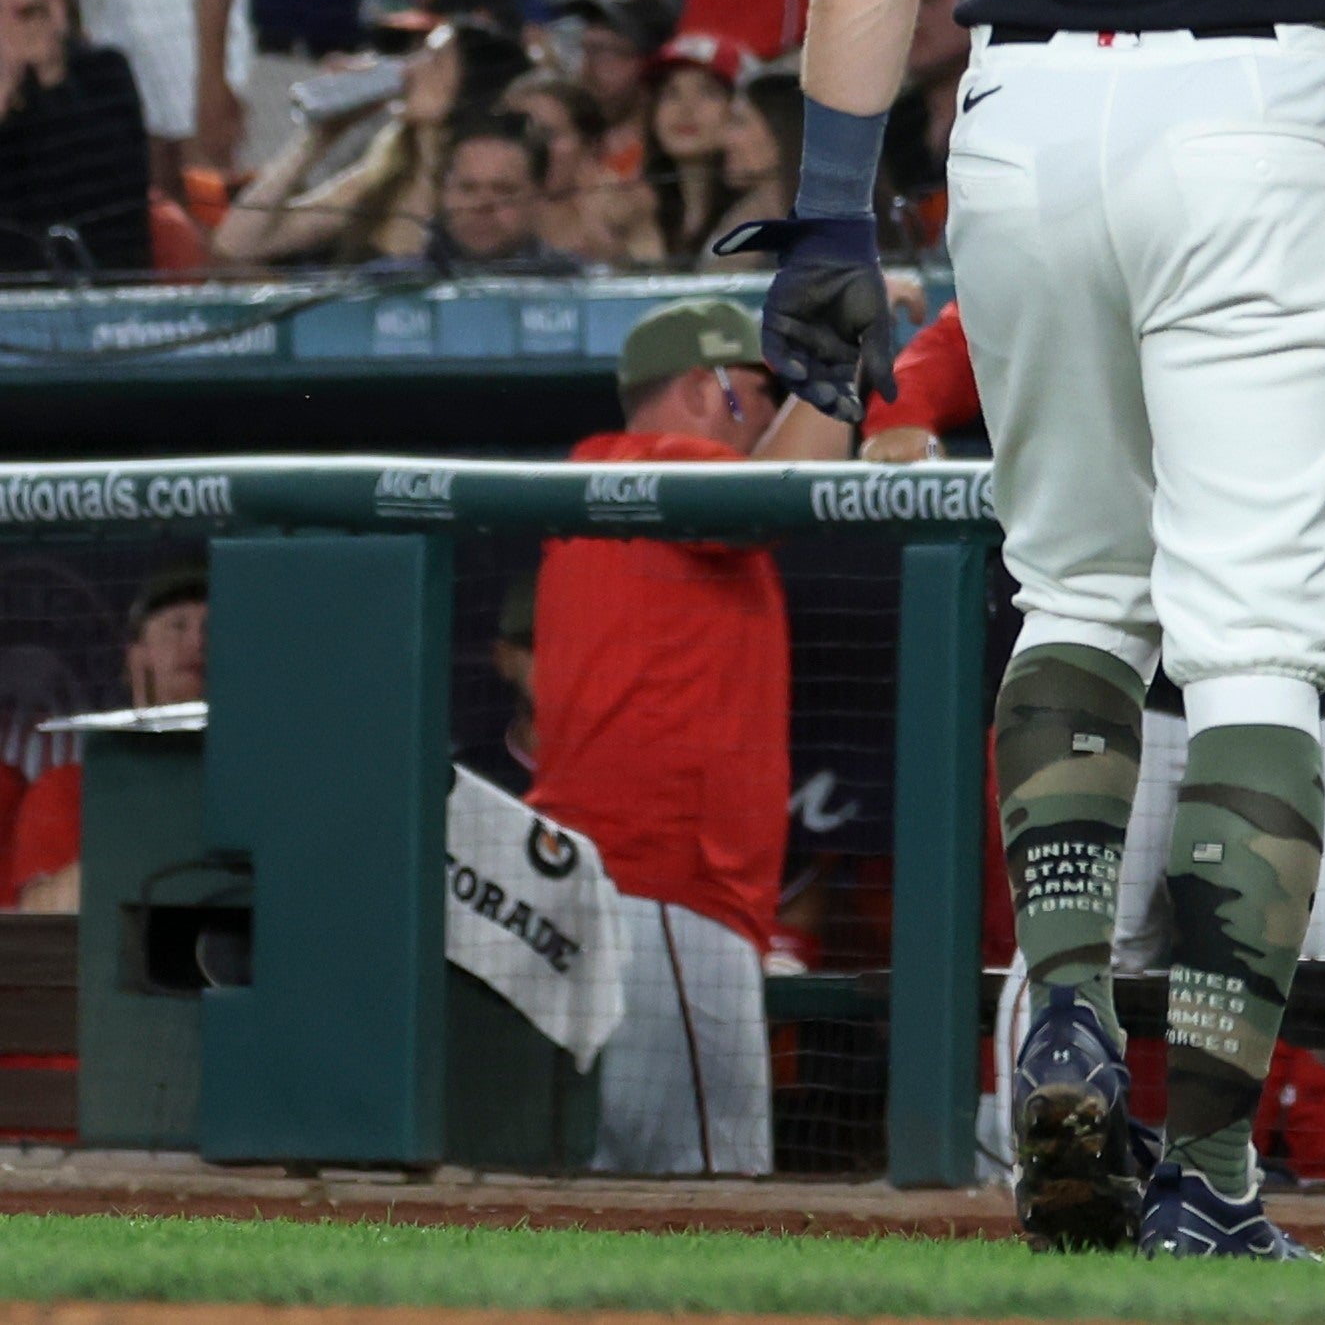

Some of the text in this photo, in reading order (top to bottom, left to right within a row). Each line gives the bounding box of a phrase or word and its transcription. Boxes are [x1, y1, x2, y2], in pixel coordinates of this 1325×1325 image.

[1027, 841, 1116, 863] UNITED
[1024, 860, 1116, 883] STATES
[1028, 877, 1113, 899] ARMED
[1028, 896, 1115, 919] FORCES
